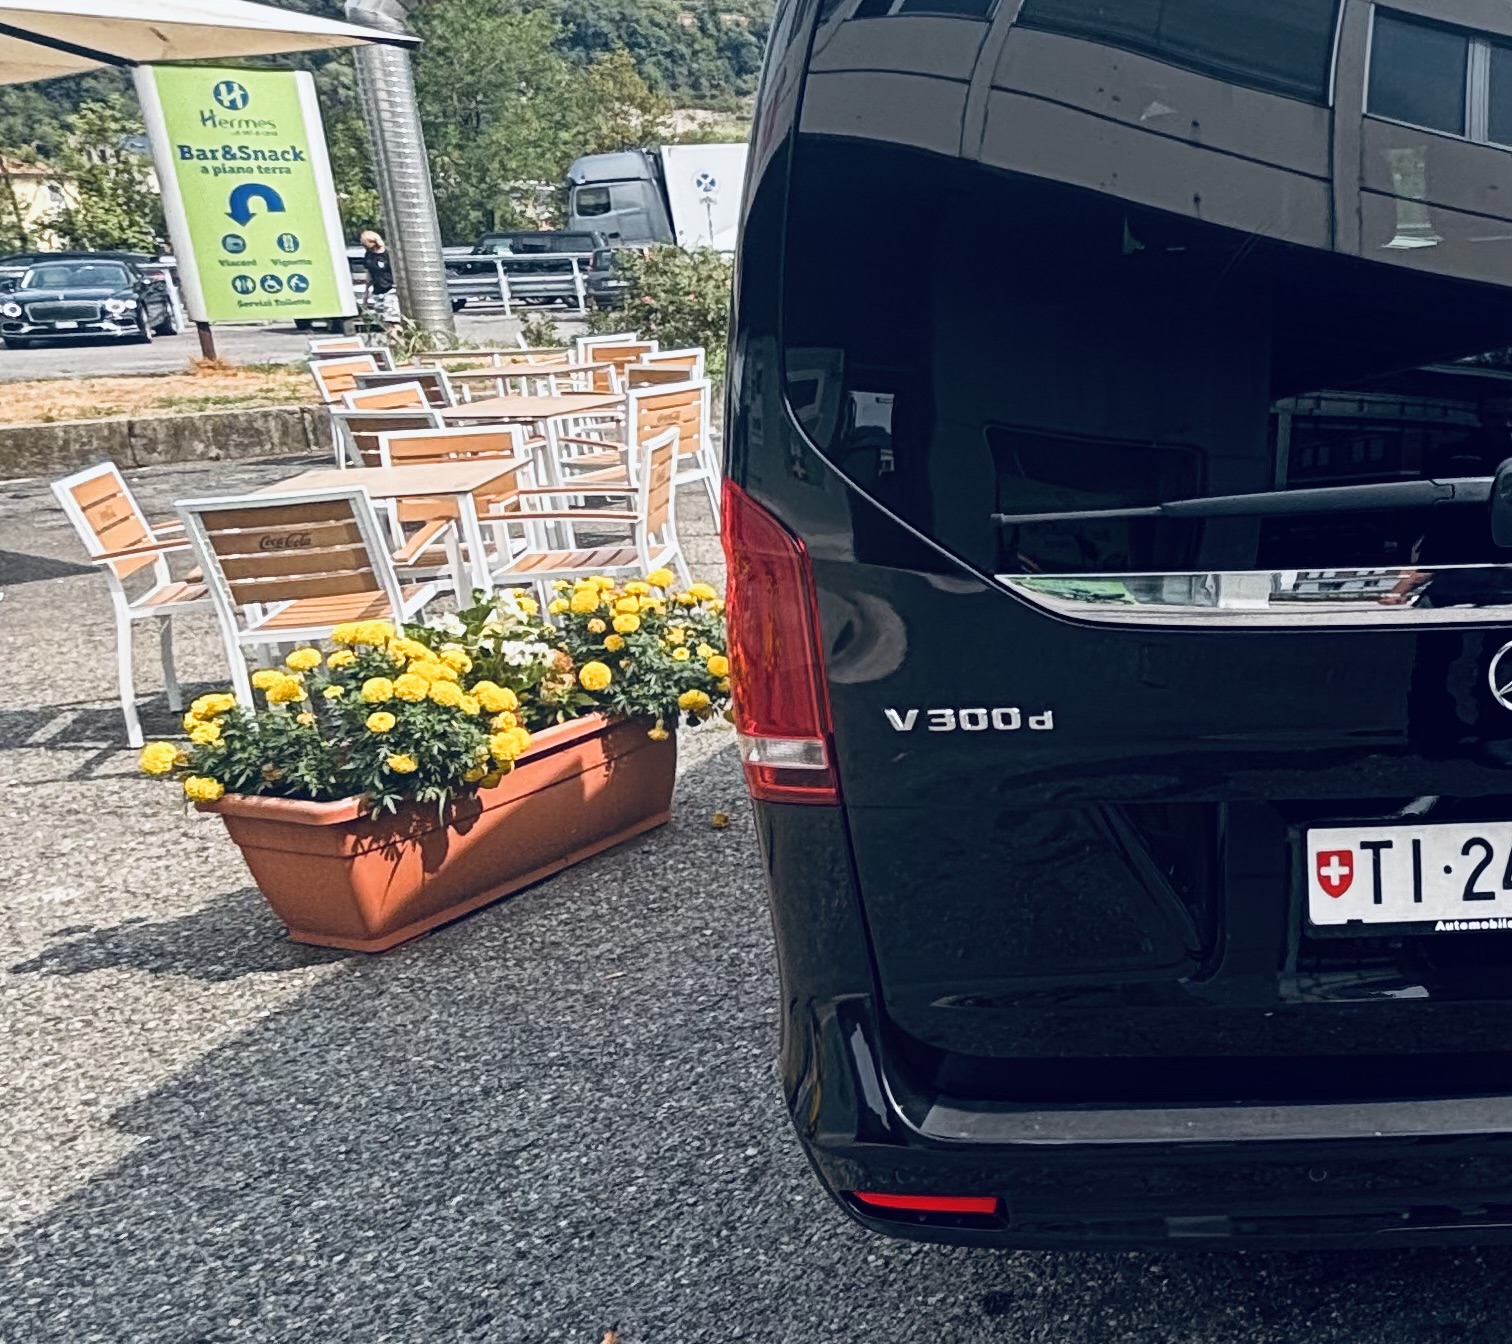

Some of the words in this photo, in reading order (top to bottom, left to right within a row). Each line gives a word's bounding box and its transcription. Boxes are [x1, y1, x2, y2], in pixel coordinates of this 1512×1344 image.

[199, 108, 277, 129] Hermes
[177, 144, 307, 162] Bar&Snack
[200, 164, 210, 174] a
[211, 163, 254, 177] piano
[256, 164, 292, 175] terra
